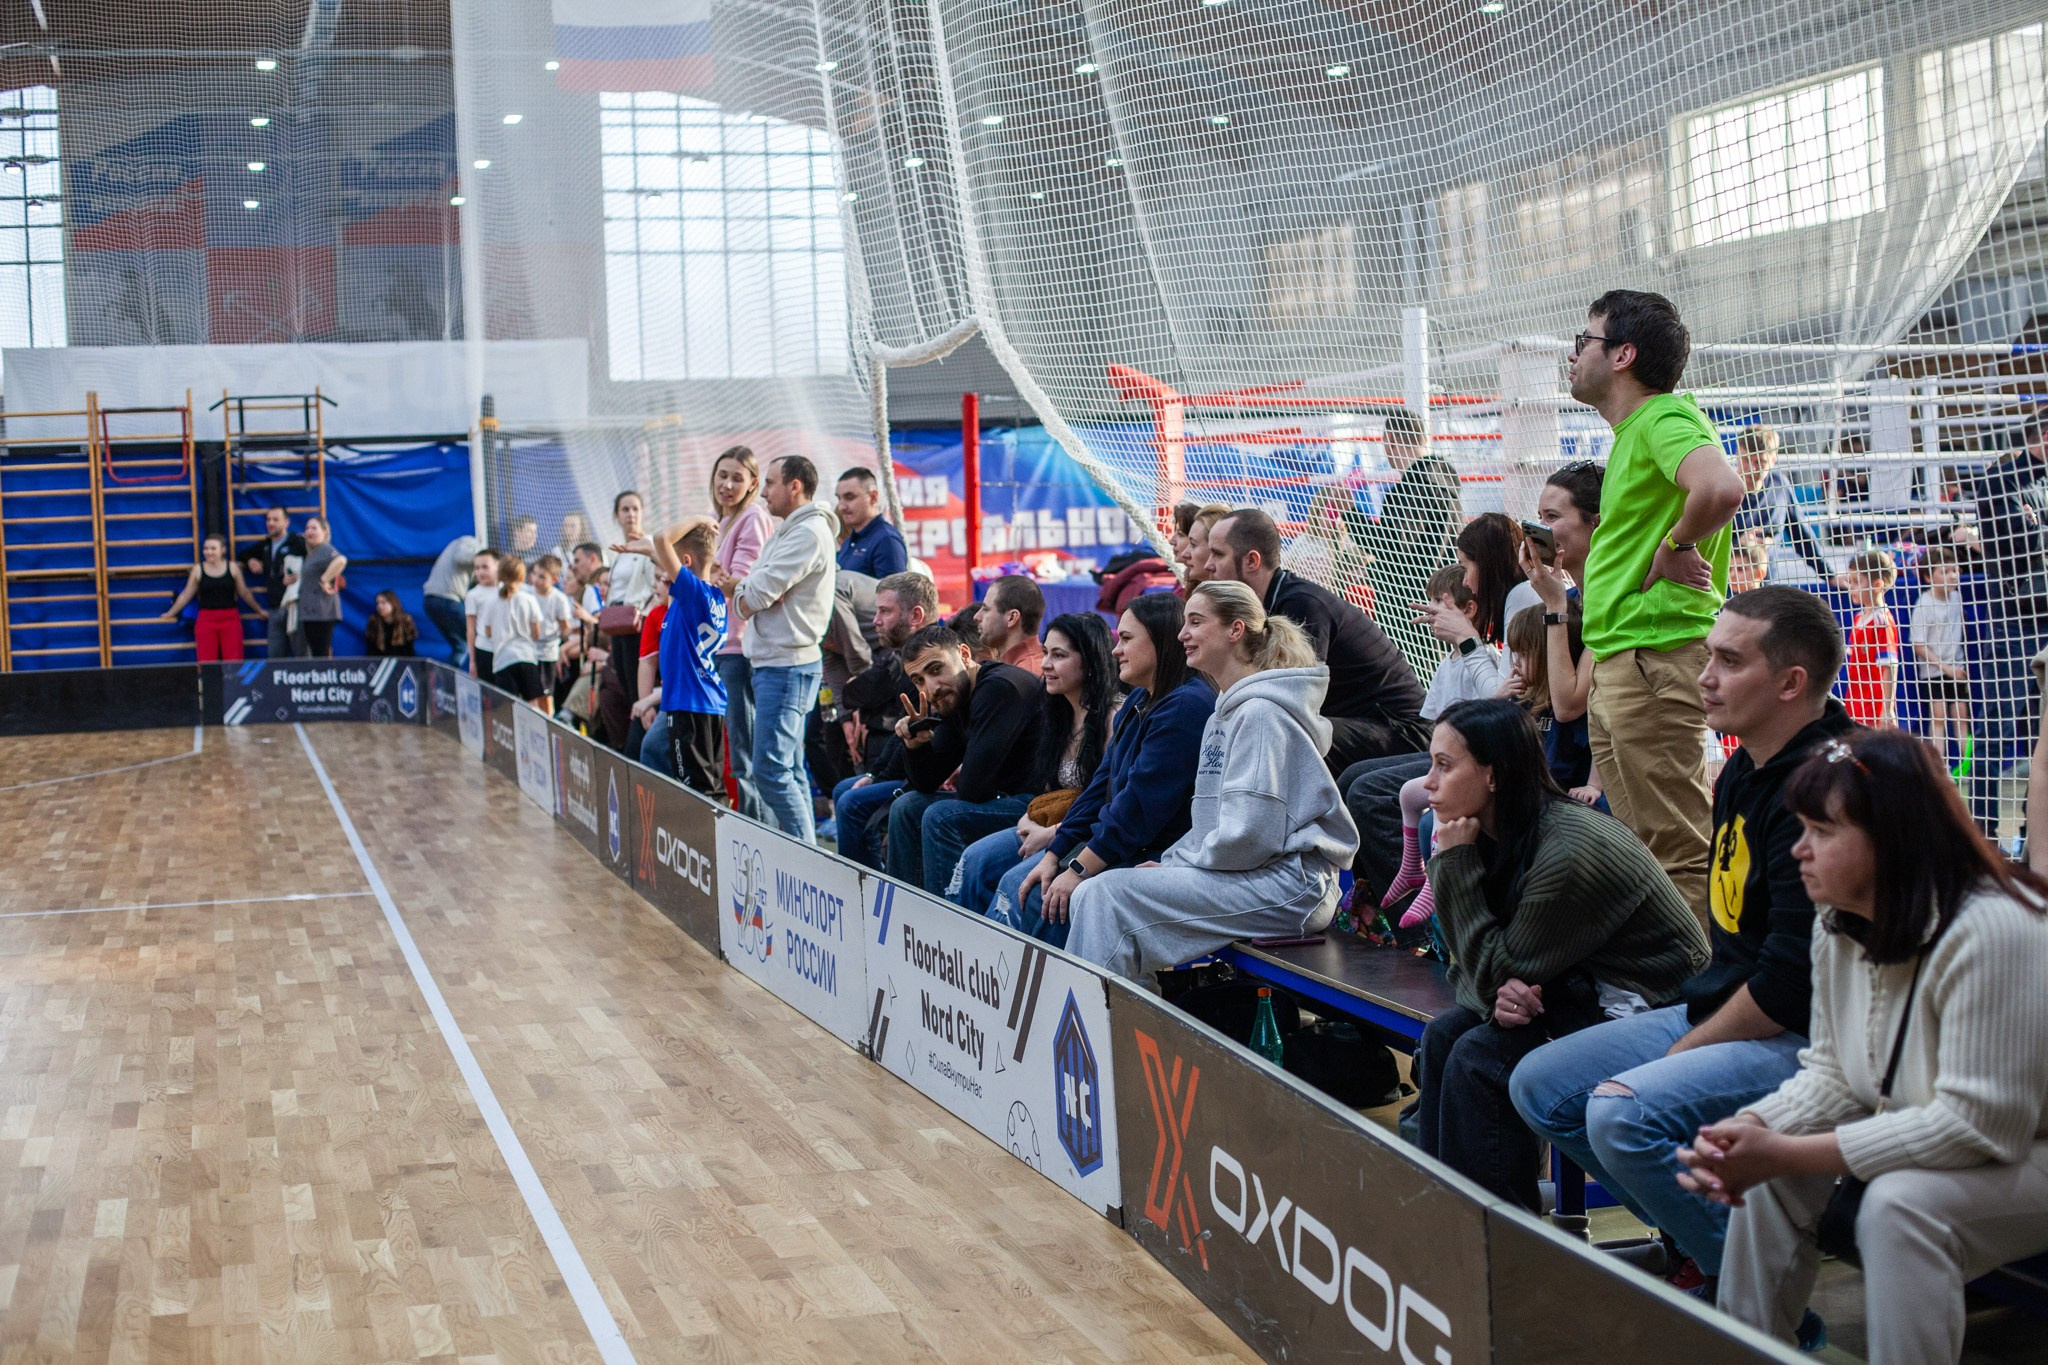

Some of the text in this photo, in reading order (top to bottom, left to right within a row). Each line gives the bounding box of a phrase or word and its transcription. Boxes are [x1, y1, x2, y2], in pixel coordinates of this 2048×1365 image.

[273, 668, 367, 685] Floorball club
[291, 687, 354, 705] Nord City
[656, 826, 712, 896] OXDOG
[776, 868, 844, 942] МИНСПОРТ
[786, 928, 837, 997] РОССИИ
[903, 924, 1000, 1010] Floorball club
[921, 989, 984, 1071] Nord City
[1210, 1145, 1452, 1365] OXDOG
